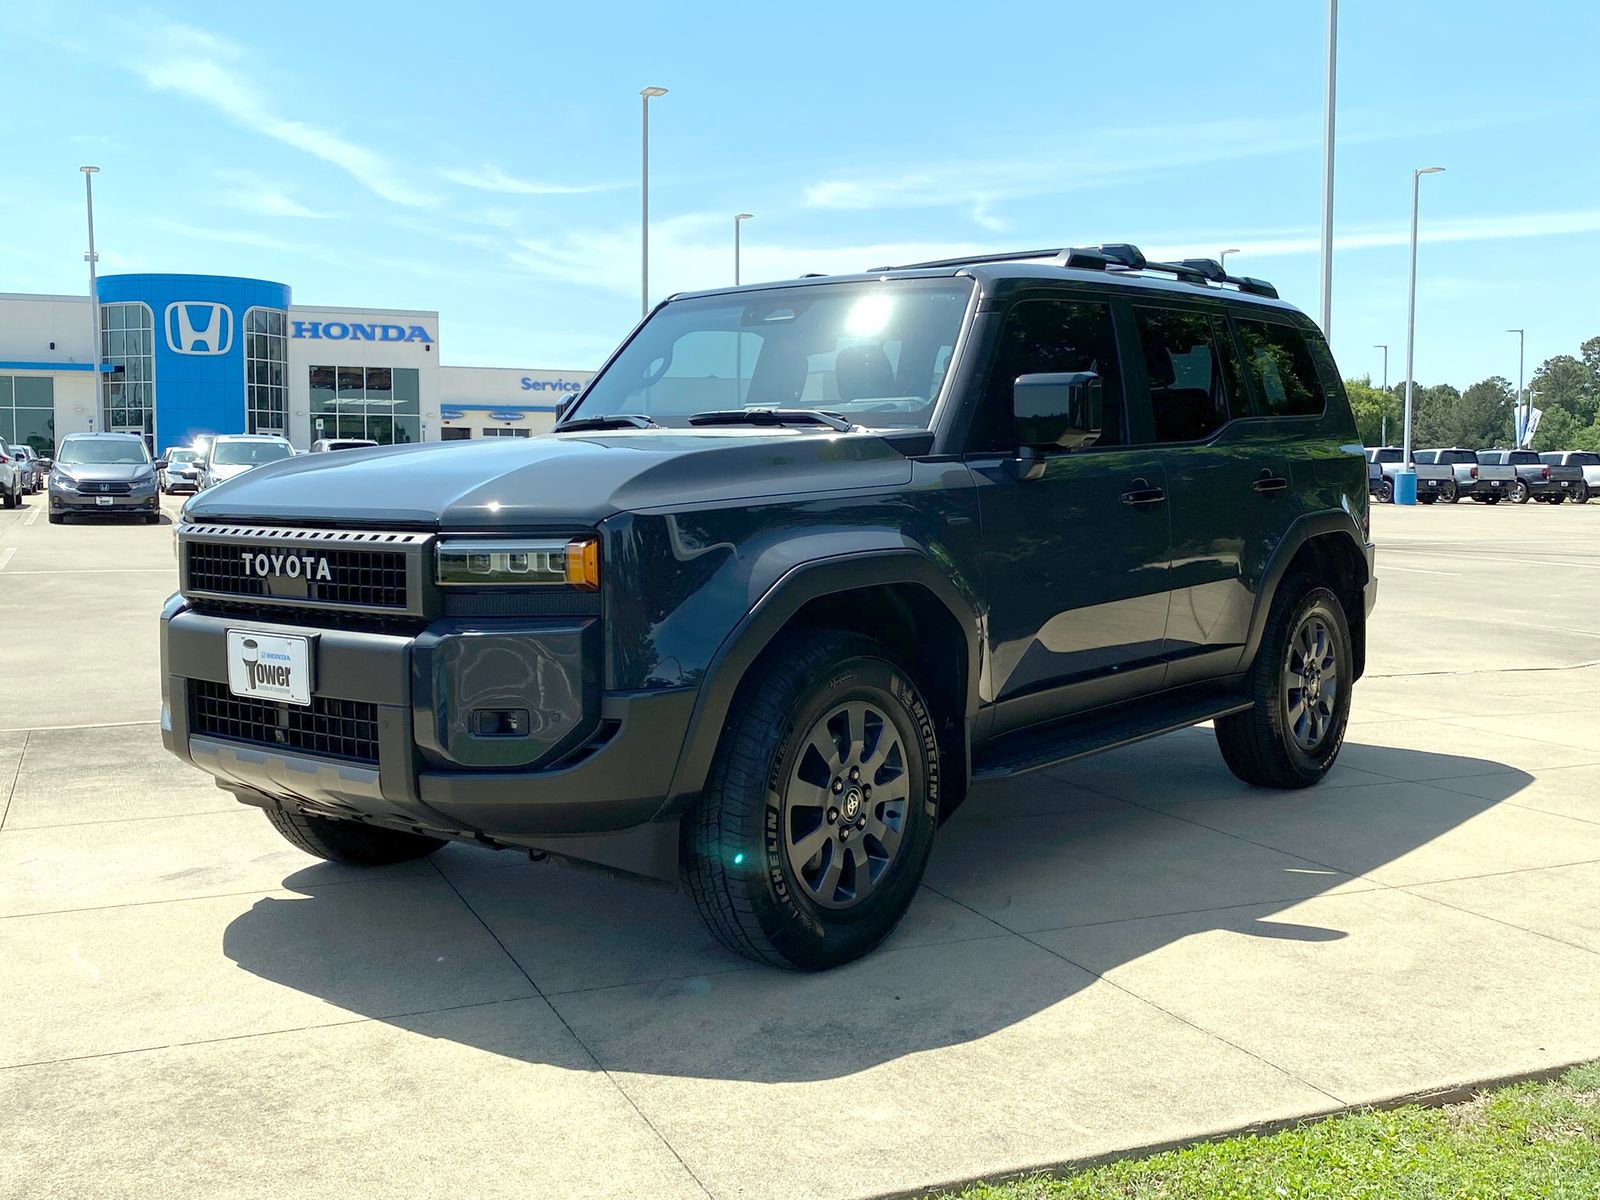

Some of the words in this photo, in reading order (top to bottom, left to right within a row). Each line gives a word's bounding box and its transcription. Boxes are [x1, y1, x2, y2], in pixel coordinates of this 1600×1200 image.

[291, 321, 434, 343] HONDA
[521, 377, 581, 392] Service
[241, 553, 332, 580] TOYOTA
[266, 653, 291, 661] HONDA
[912, 700, 938, 799] MICHELIN
